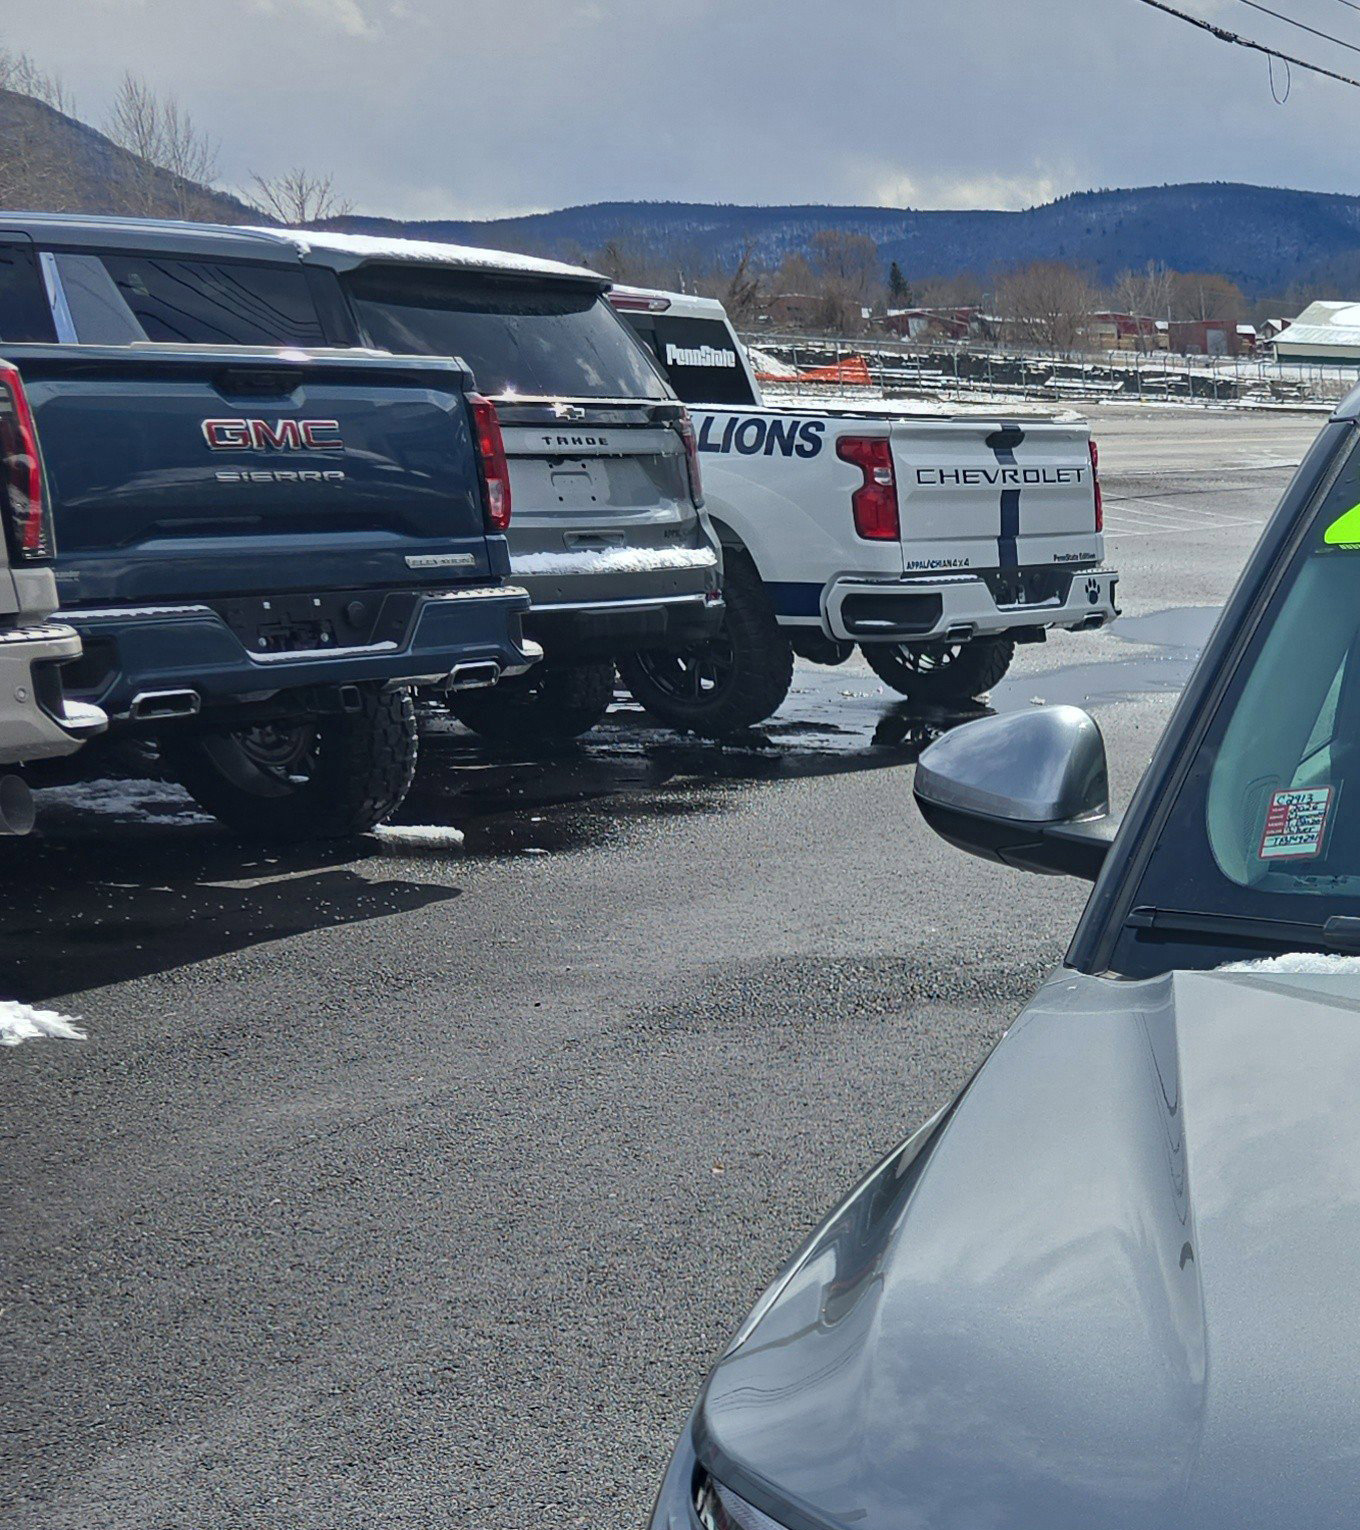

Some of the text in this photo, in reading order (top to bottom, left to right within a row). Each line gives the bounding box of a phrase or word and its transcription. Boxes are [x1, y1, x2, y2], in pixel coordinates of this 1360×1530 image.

[201, 419, 344, 451] GMC
[541, 436, 609, 446] TAHOE
[698, 416, 826, 459] LIONS
[215, 471, 346, 483] SIERRA
[916, 468, 1086, 485] CHEVROLET
